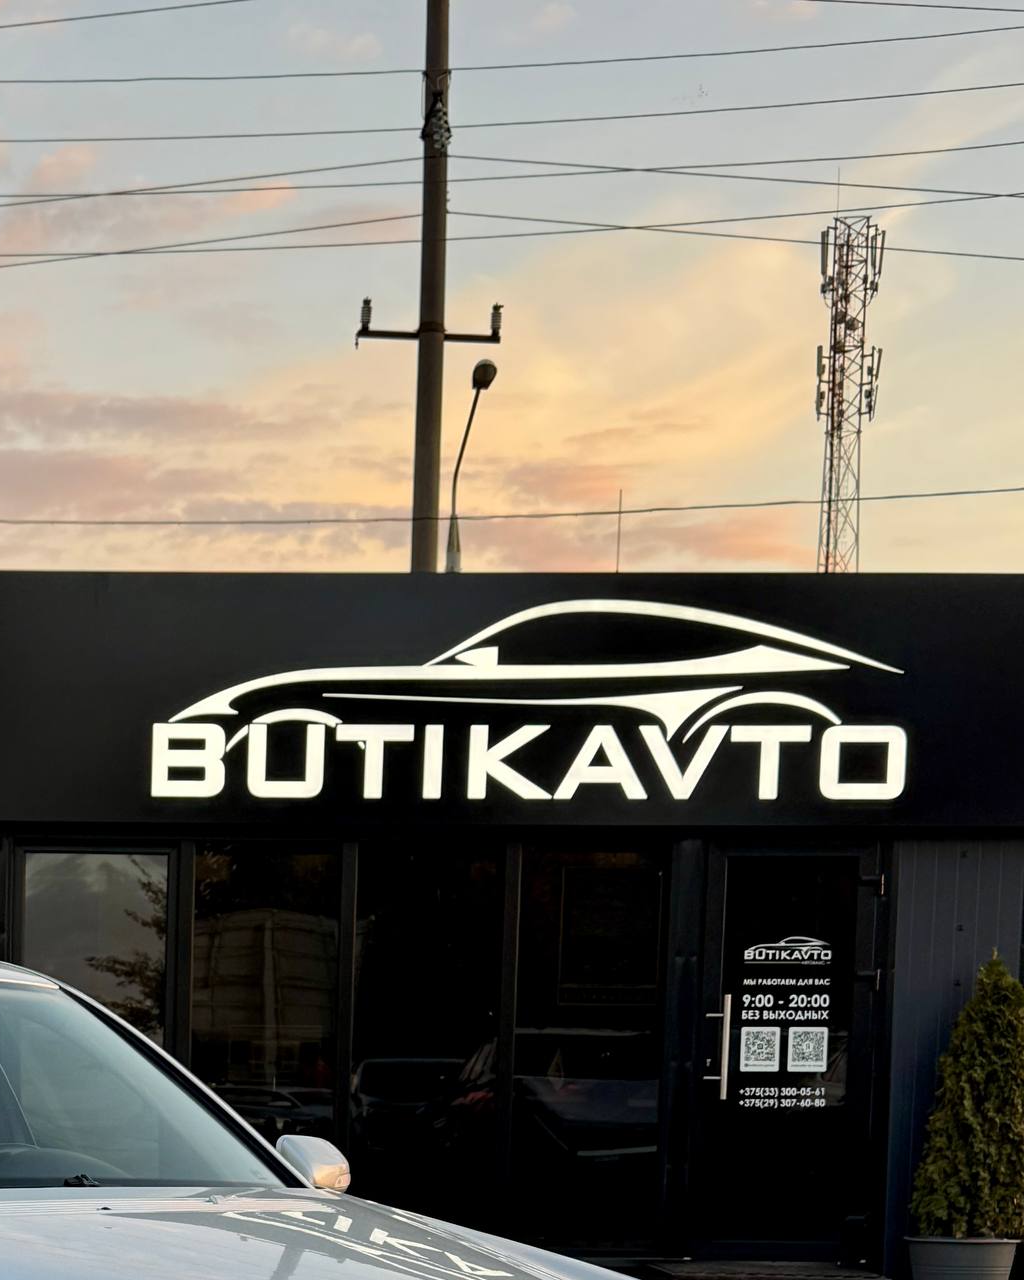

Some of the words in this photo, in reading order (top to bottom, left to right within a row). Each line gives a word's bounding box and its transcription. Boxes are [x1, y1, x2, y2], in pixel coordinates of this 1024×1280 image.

[150, 722, 907, 801] BUTIKAVTO
[743, 949, 832, 960] BUTIKAVTO
[743, 978, 757, 986] МЫ
[758, 978, 796, 986] РАБОТАЕМ
[797, 978, 813, 986] ДЛЯ
[814, 978, 831, 986] ВАС
[742, 994, 774, 1008] 9:00
[788, 994, 830, 1008] 20:00
[741, 1010, 760, 1020] БЕЗ
[762, 1010, 829, 1021] ВЫХОДНЫХ
